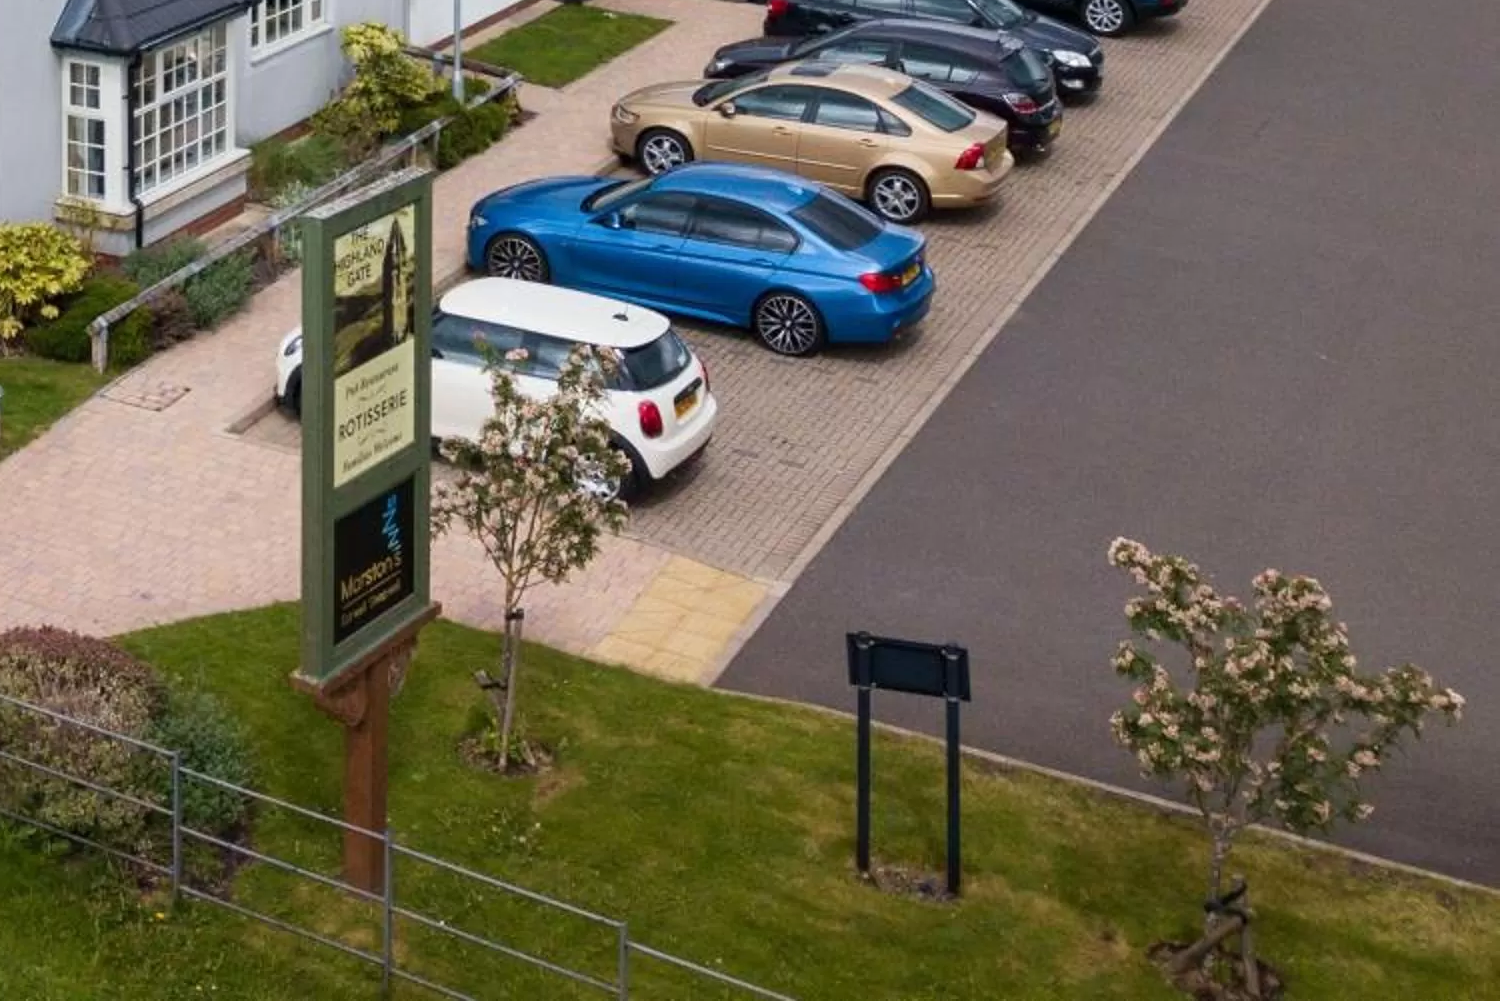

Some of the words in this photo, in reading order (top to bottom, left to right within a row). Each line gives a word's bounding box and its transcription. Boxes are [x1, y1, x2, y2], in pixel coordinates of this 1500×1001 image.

[334, 238, 385, 271] HIGHLAND
[347, 262, 371, 287] GATE
[339, 387, 408, 441] ROTISSERIE
